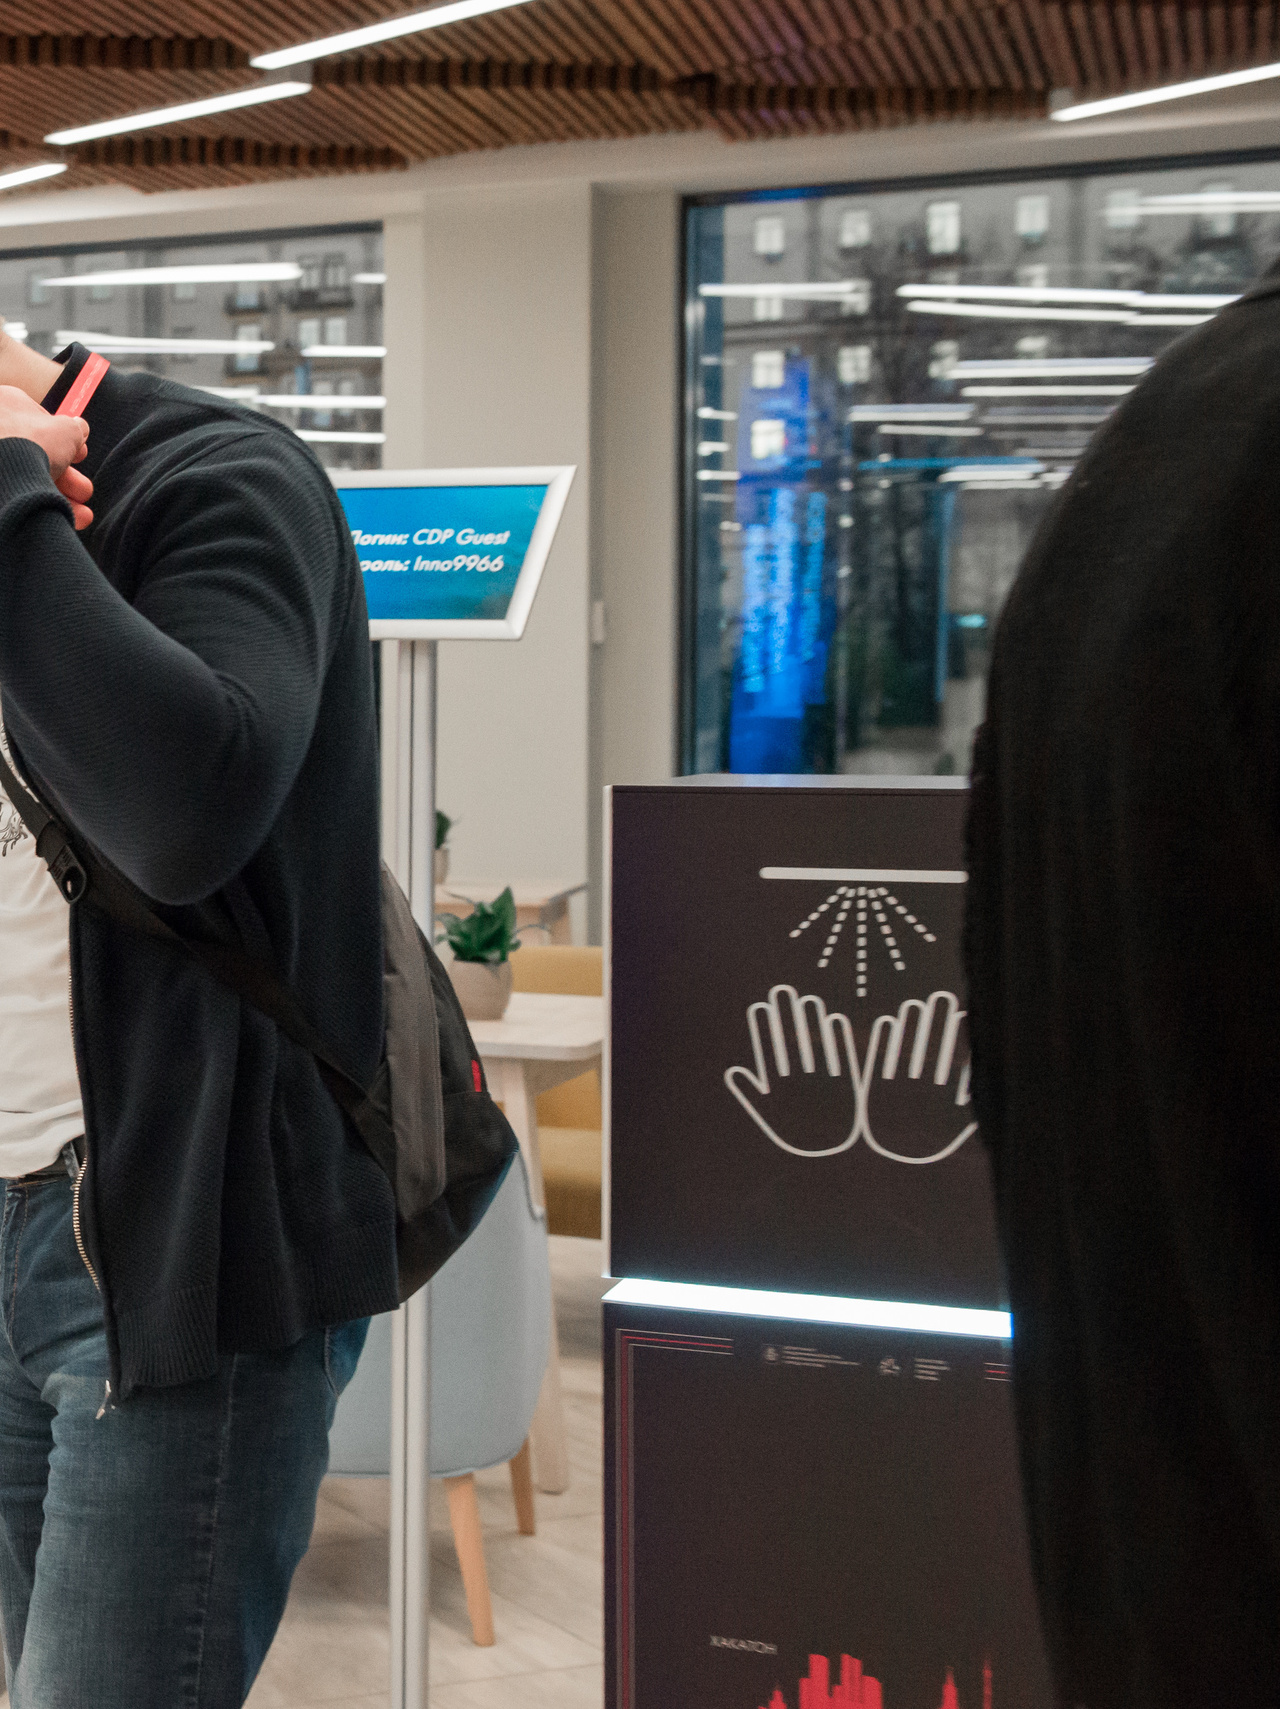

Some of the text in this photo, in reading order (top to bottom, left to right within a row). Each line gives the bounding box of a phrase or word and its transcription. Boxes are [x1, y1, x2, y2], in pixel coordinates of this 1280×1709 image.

[412, 528, 454, 546] CDP
[456, 528, 510, 546] Guest
[413, 555, 504, 572] Inno9966
[710, 1634, 778, 1655] ХАКАТОН
